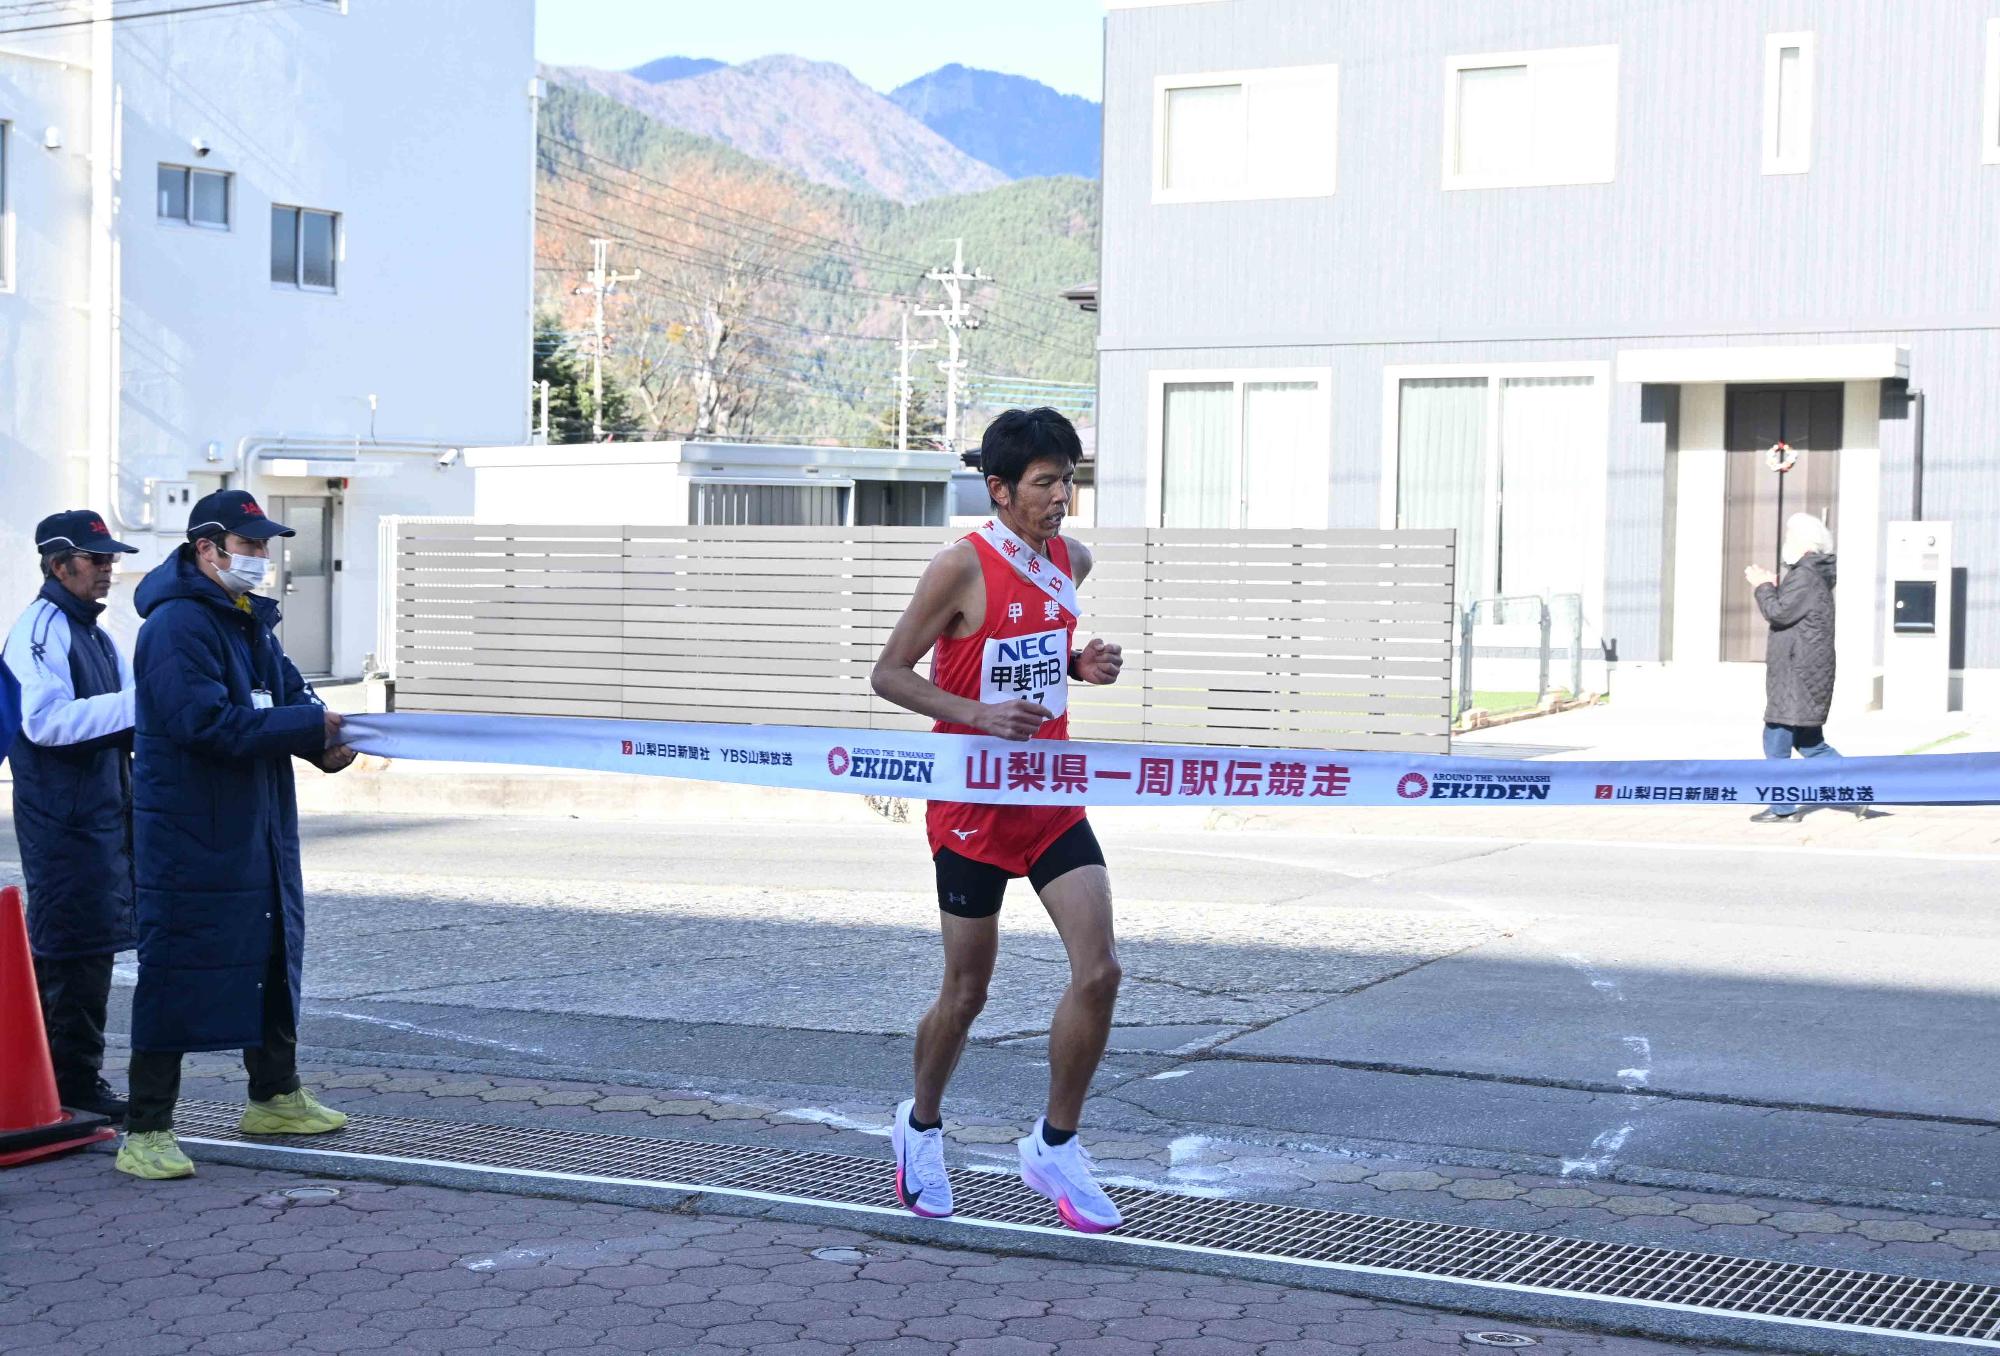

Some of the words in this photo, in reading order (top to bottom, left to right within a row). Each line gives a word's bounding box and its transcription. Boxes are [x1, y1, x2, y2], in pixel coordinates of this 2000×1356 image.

[998, 634, 1057, 662] NEC
[991, 658, 1061, 691] 甲斐市B
[635, 742, 710, 761] 山梨日日新聞社
[720, 748, 793, 766] YBS山梨放送
[850, 756, 934, 783] EKIDEN
[965, 749, 1351, 797] 山梨県一周駅伝競走
[1433, 773, 1473, 781] AROUND
[1475, 774, 1493, 782] THE
[1497, 775, 1551, 783] YAMANASHI
[1430, 782, 1550, 800] EKIDEN
[1616, 785, 1738, 801] 山梨日日新聞社
[1755, 786, 1875, 802] YBS山梨放送
